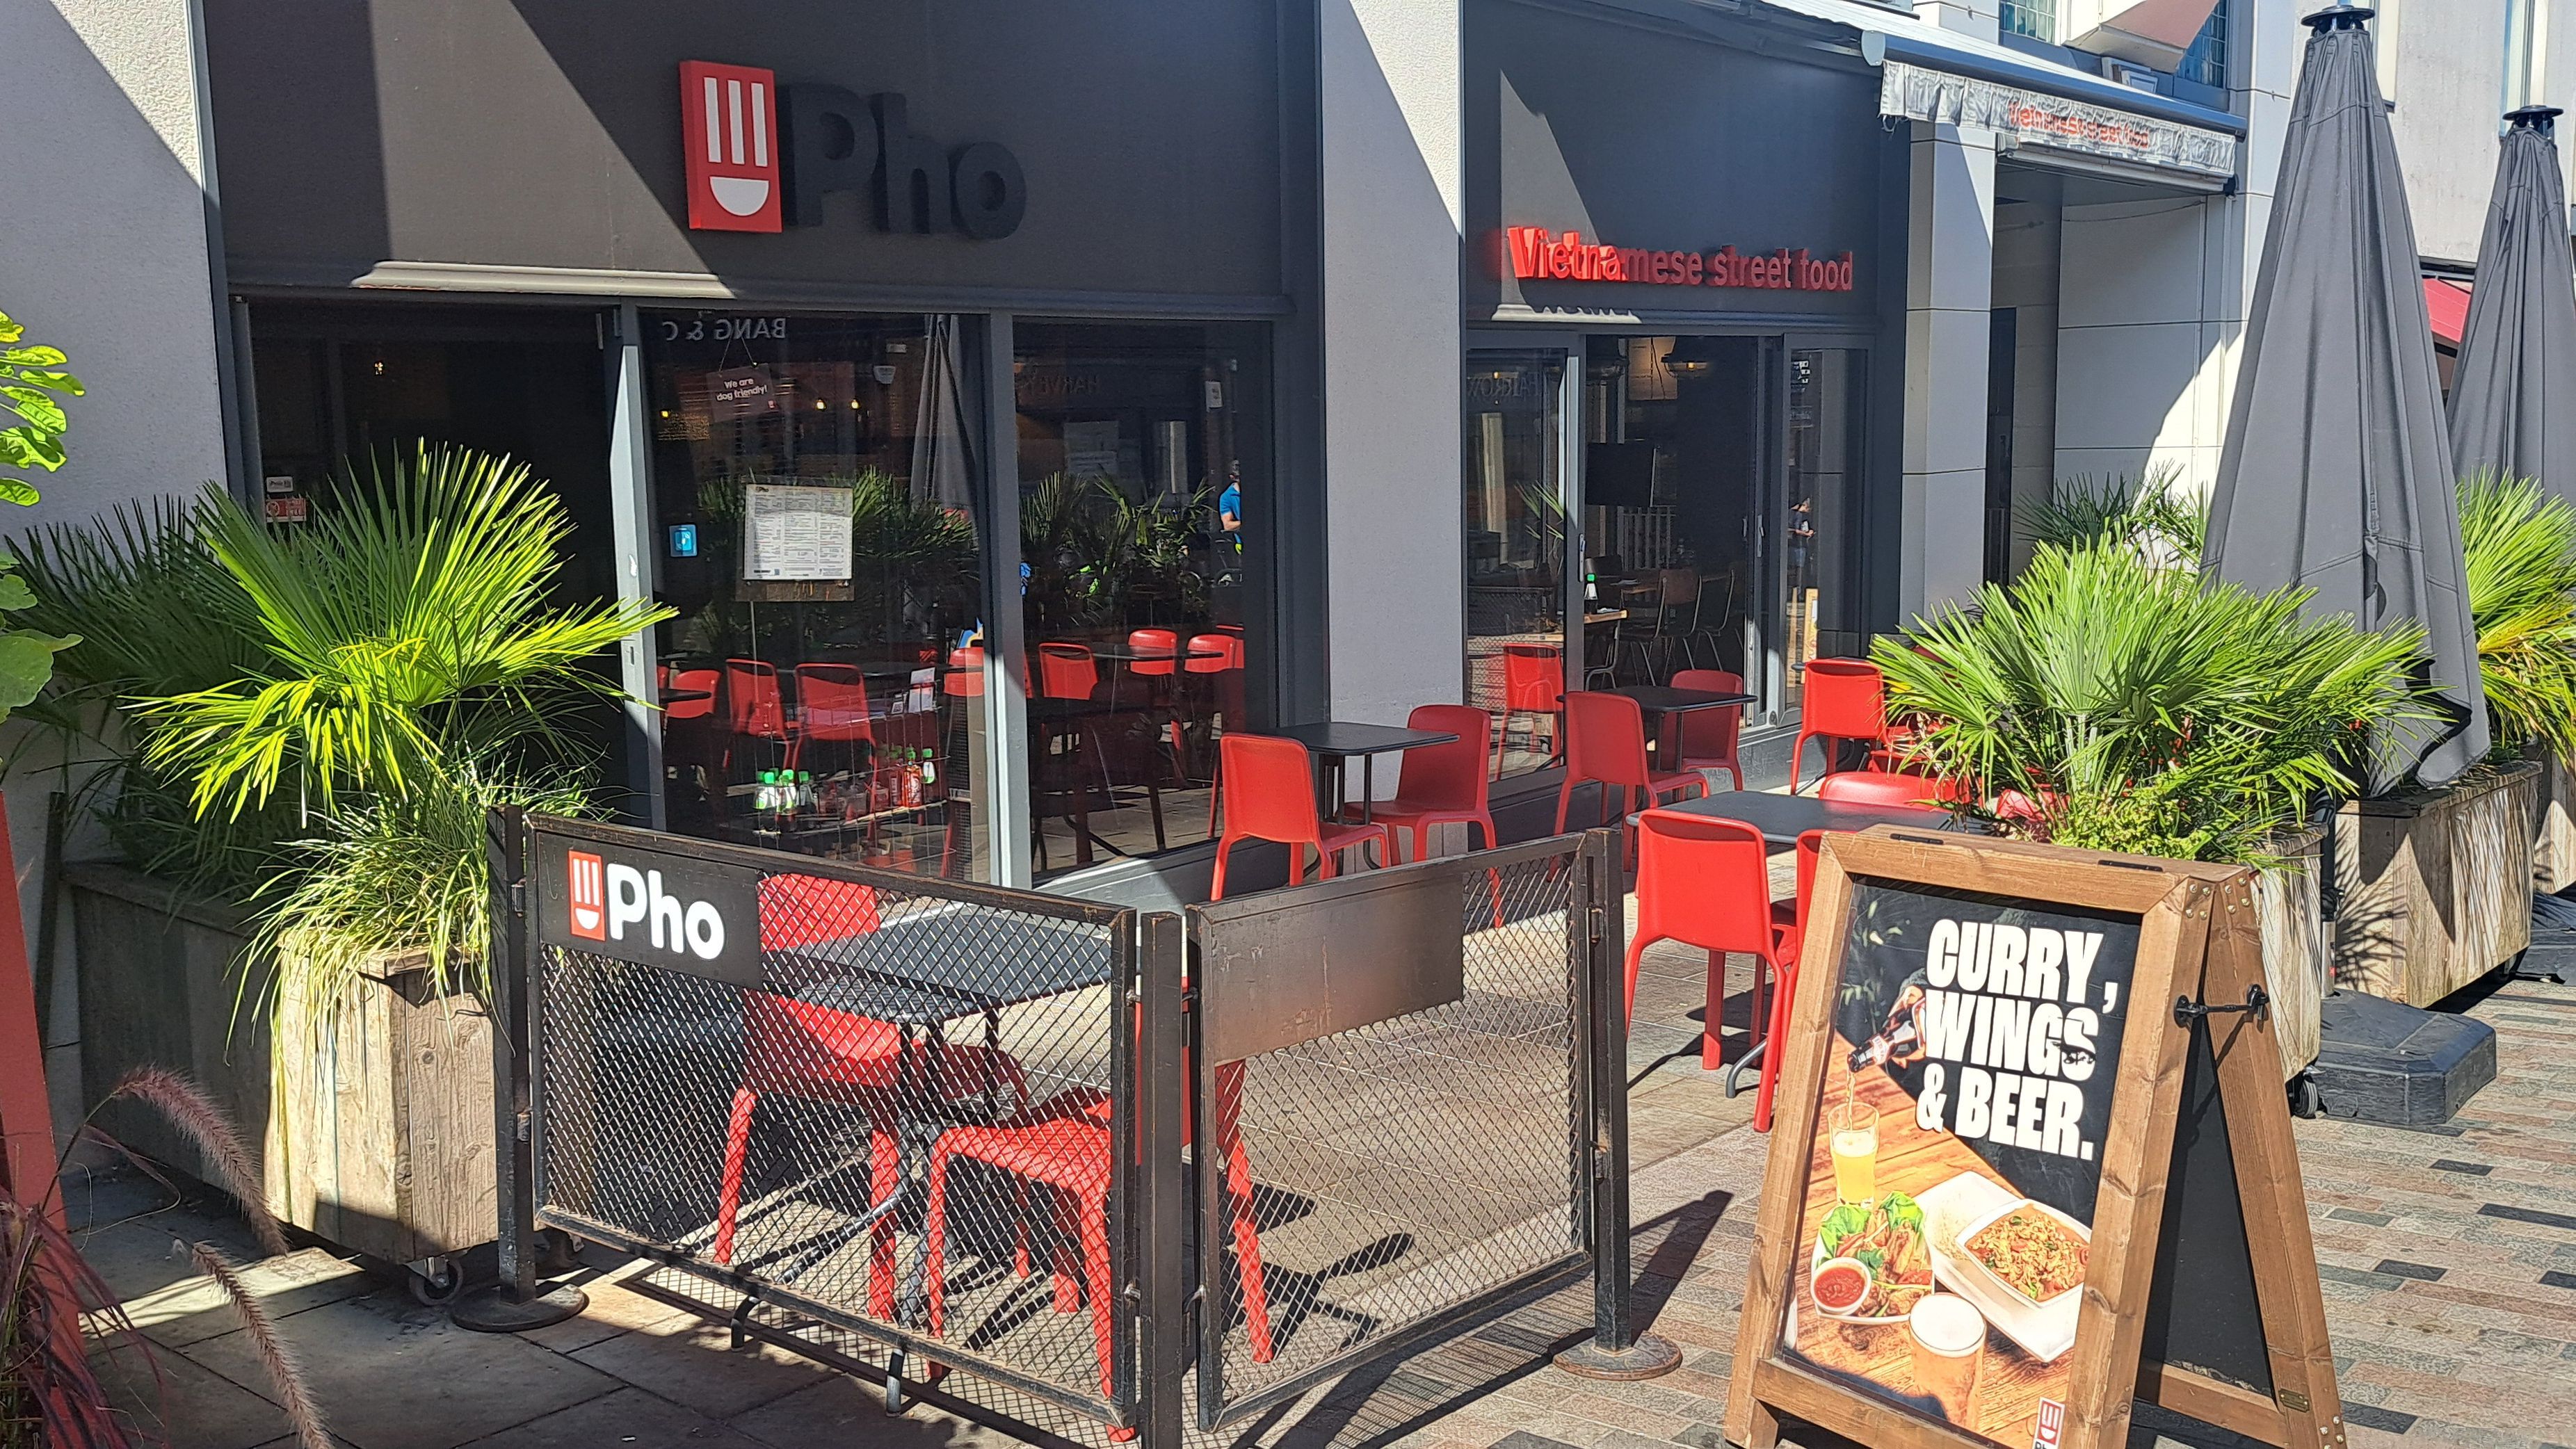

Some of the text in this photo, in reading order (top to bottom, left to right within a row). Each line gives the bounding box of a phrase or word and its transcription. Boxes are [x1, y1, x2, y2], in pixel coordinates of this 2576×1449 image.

[786, 82, 1027, 240] Pho
[1507, 226, 1853, 292] Vietnamese street food
[716, 384, 768, 403] dog friendly!
[724, 377, 754, 389] We are
[606, 863, 725, 960] Pho
[1925, 918, 2118, 1014] CURRY,
[1924, 989, 2099, 1081] WINGS
[1916, 1063, 2094, 1161] & BEER.
